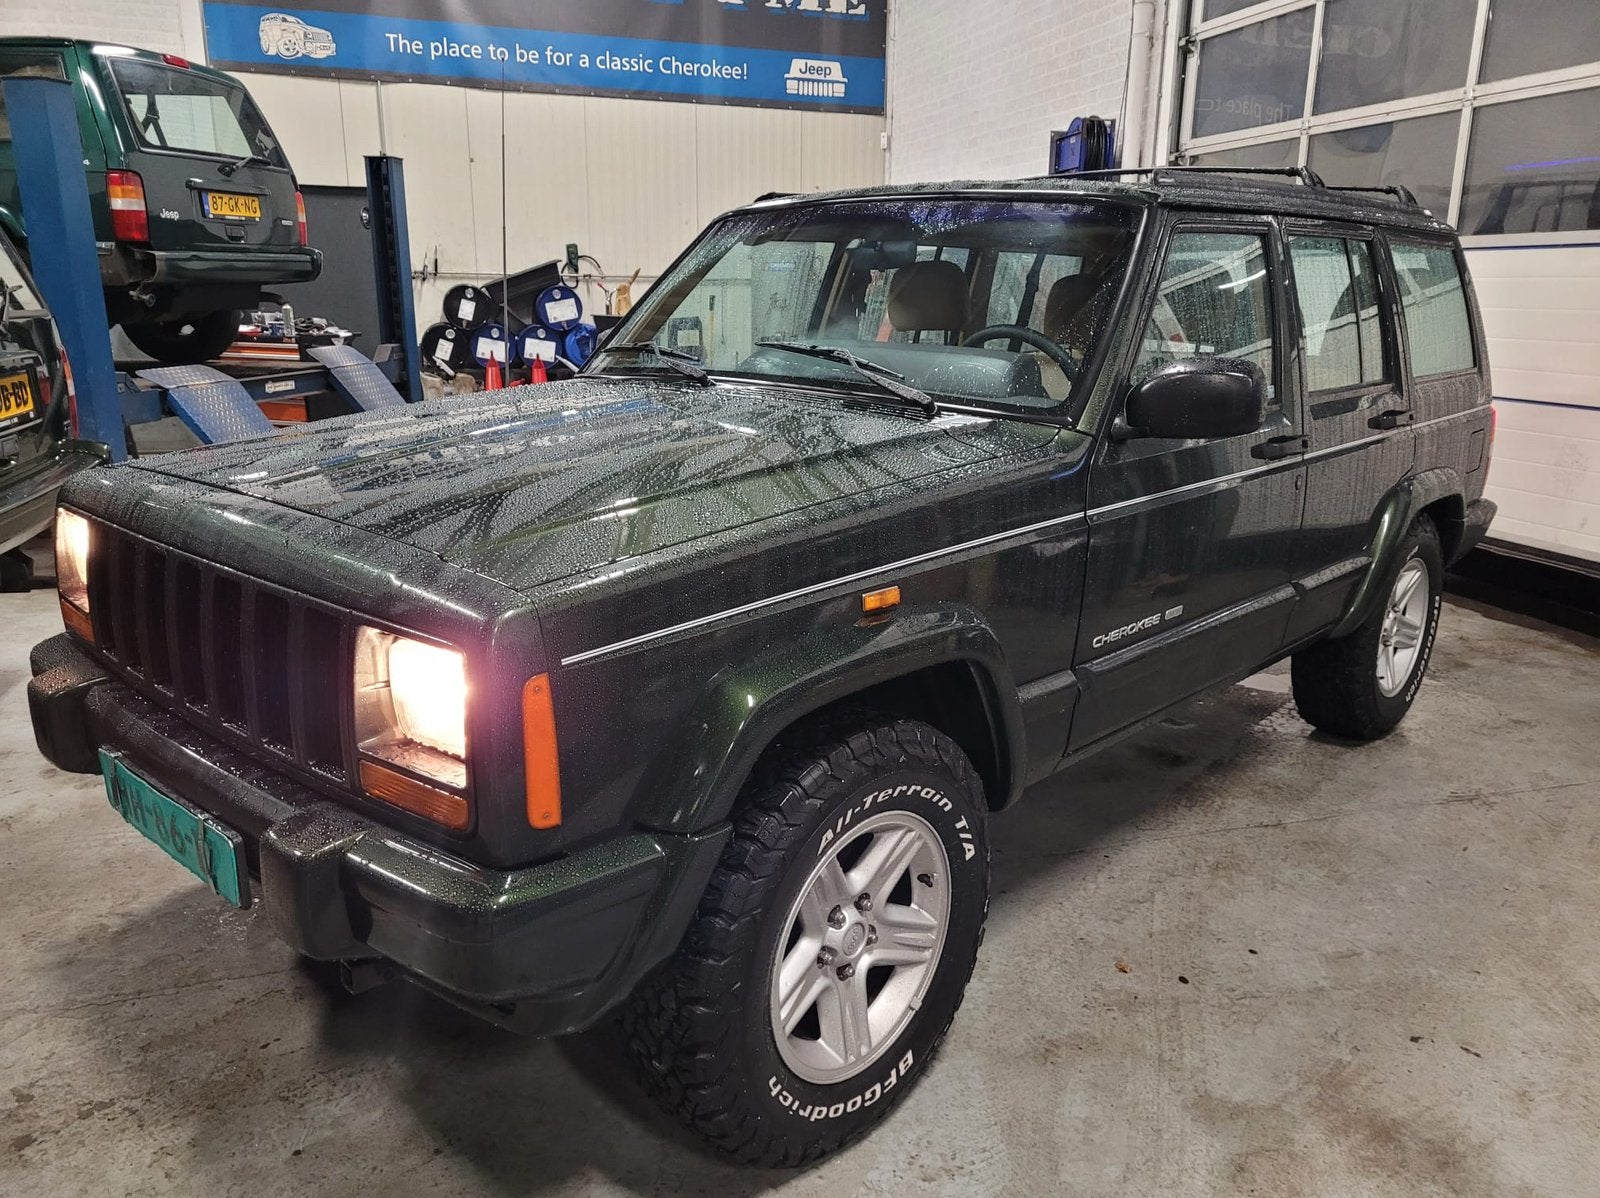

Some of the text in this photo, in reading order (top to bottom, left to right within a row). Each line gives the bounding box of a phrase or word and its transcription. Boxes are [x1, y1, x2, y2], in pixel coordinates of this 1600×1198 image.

[385, 33, 748, 80] The place to be for a classic Cherokee!
[798, 61, 832, 78] Jeep
[160, 208, 180, 221] Jeep
[211, 195, 258, 214] 87-GK-NG
[0, 381, 28, 411] B-BD
[1092, 612, 1161, 648] CHEROKEE
[817, 784, 976, 862] All-Terrain T/A
[767, 1048, 915, 1122] BFGoodrich
